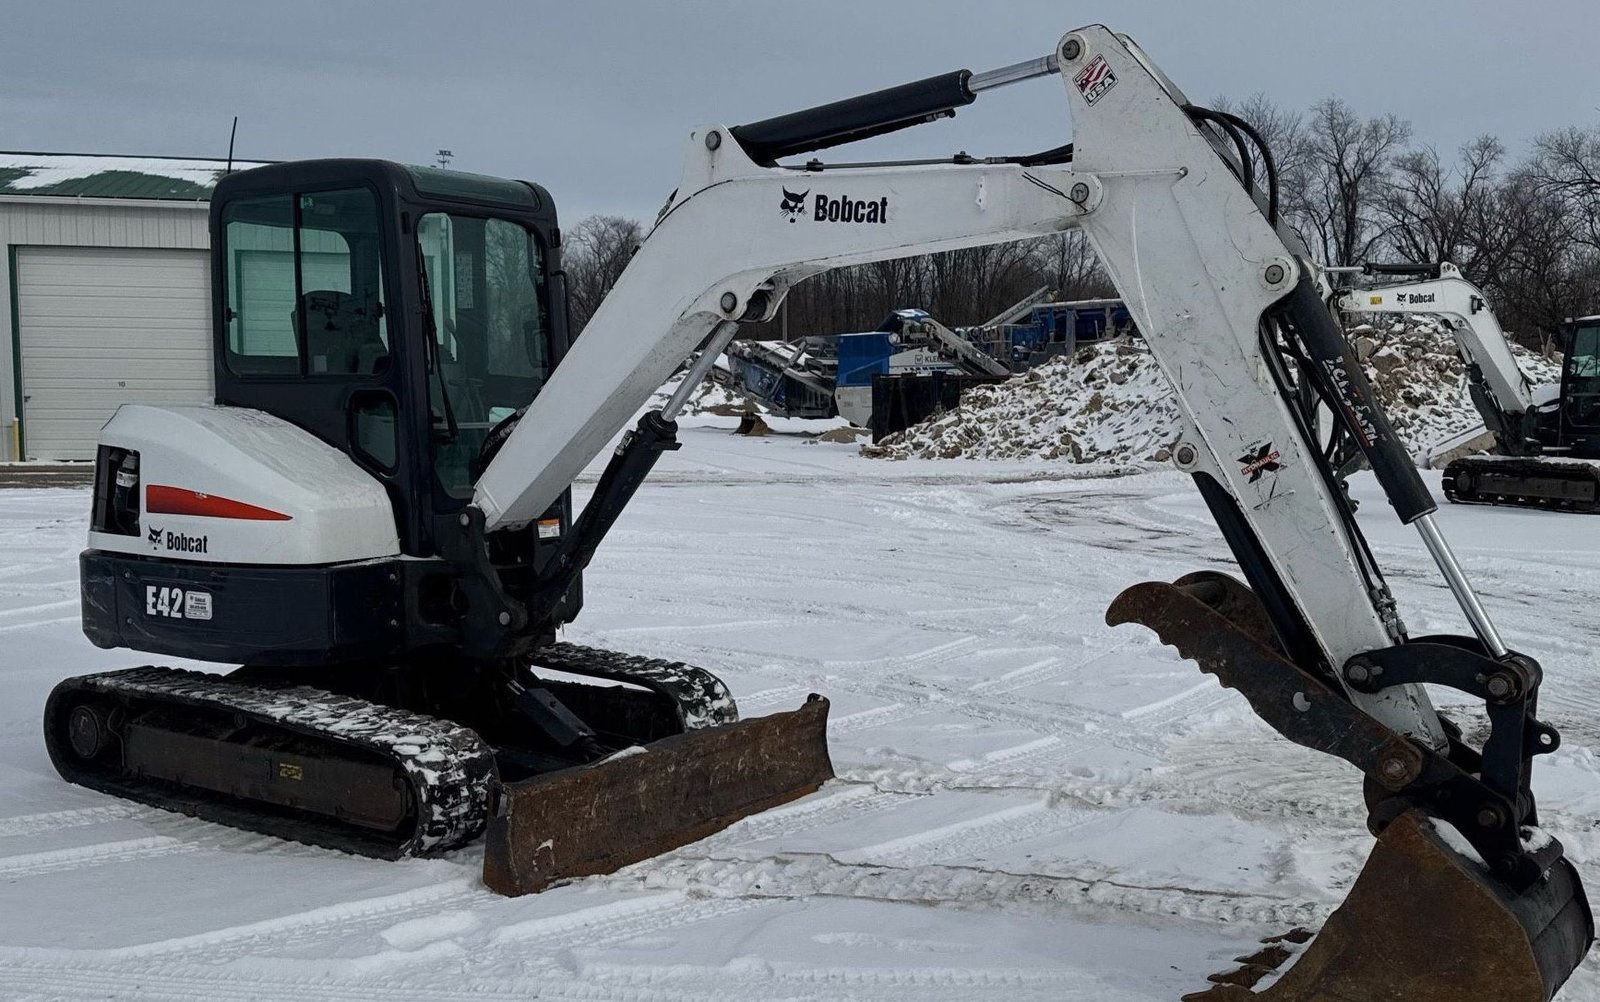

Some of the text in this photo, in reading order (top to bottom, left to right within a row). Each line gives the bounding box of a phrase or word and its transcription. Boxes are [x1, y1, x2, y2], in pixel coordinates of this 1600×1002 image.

[1086, 76, 1114, 101] USA
[814, 194, 888, 224] Bobcat
[1409, 293, 1435, 304] Bobcat
[1241, 450, 1281, 476] HYDRAULIC
[166, 531, 208, 554] Bobcat
[146, 585, 183, 618] E42
